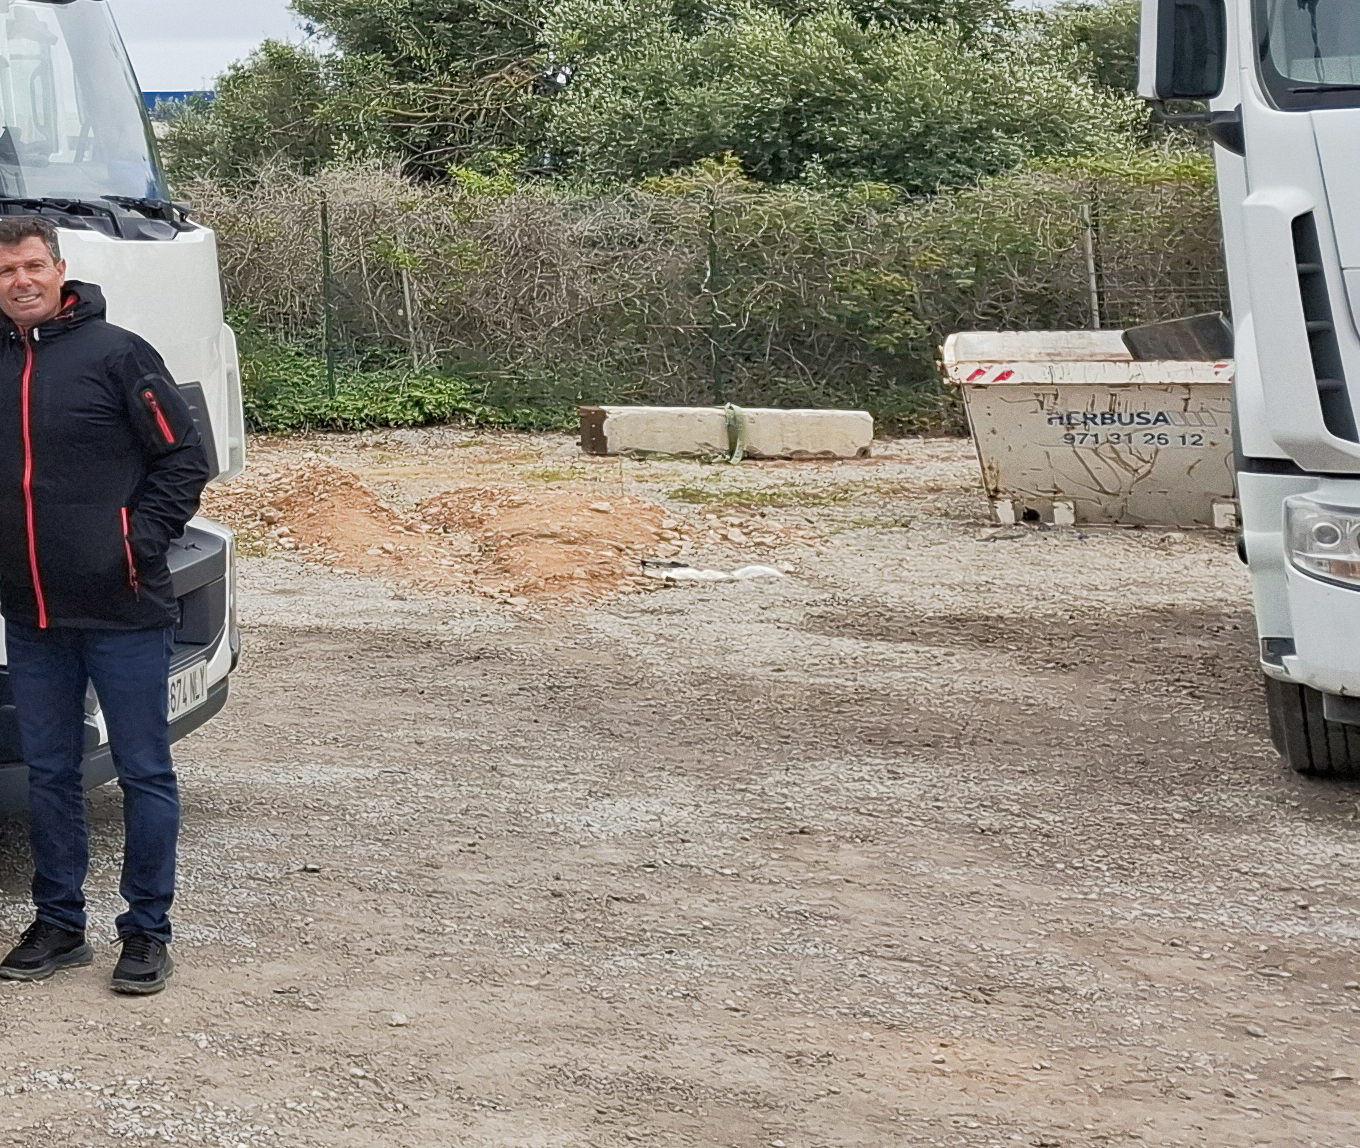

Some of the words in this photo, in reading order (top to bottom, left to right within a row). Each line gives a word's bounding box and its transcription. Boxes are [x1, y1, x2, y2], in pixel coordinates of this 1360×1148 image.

[1063, 432, 1100, 446] 971
[1108, 432, 1134, 445] 31
[1142, 432, 1170, 446] 26
[1178, 433, 1204, 447] 12
